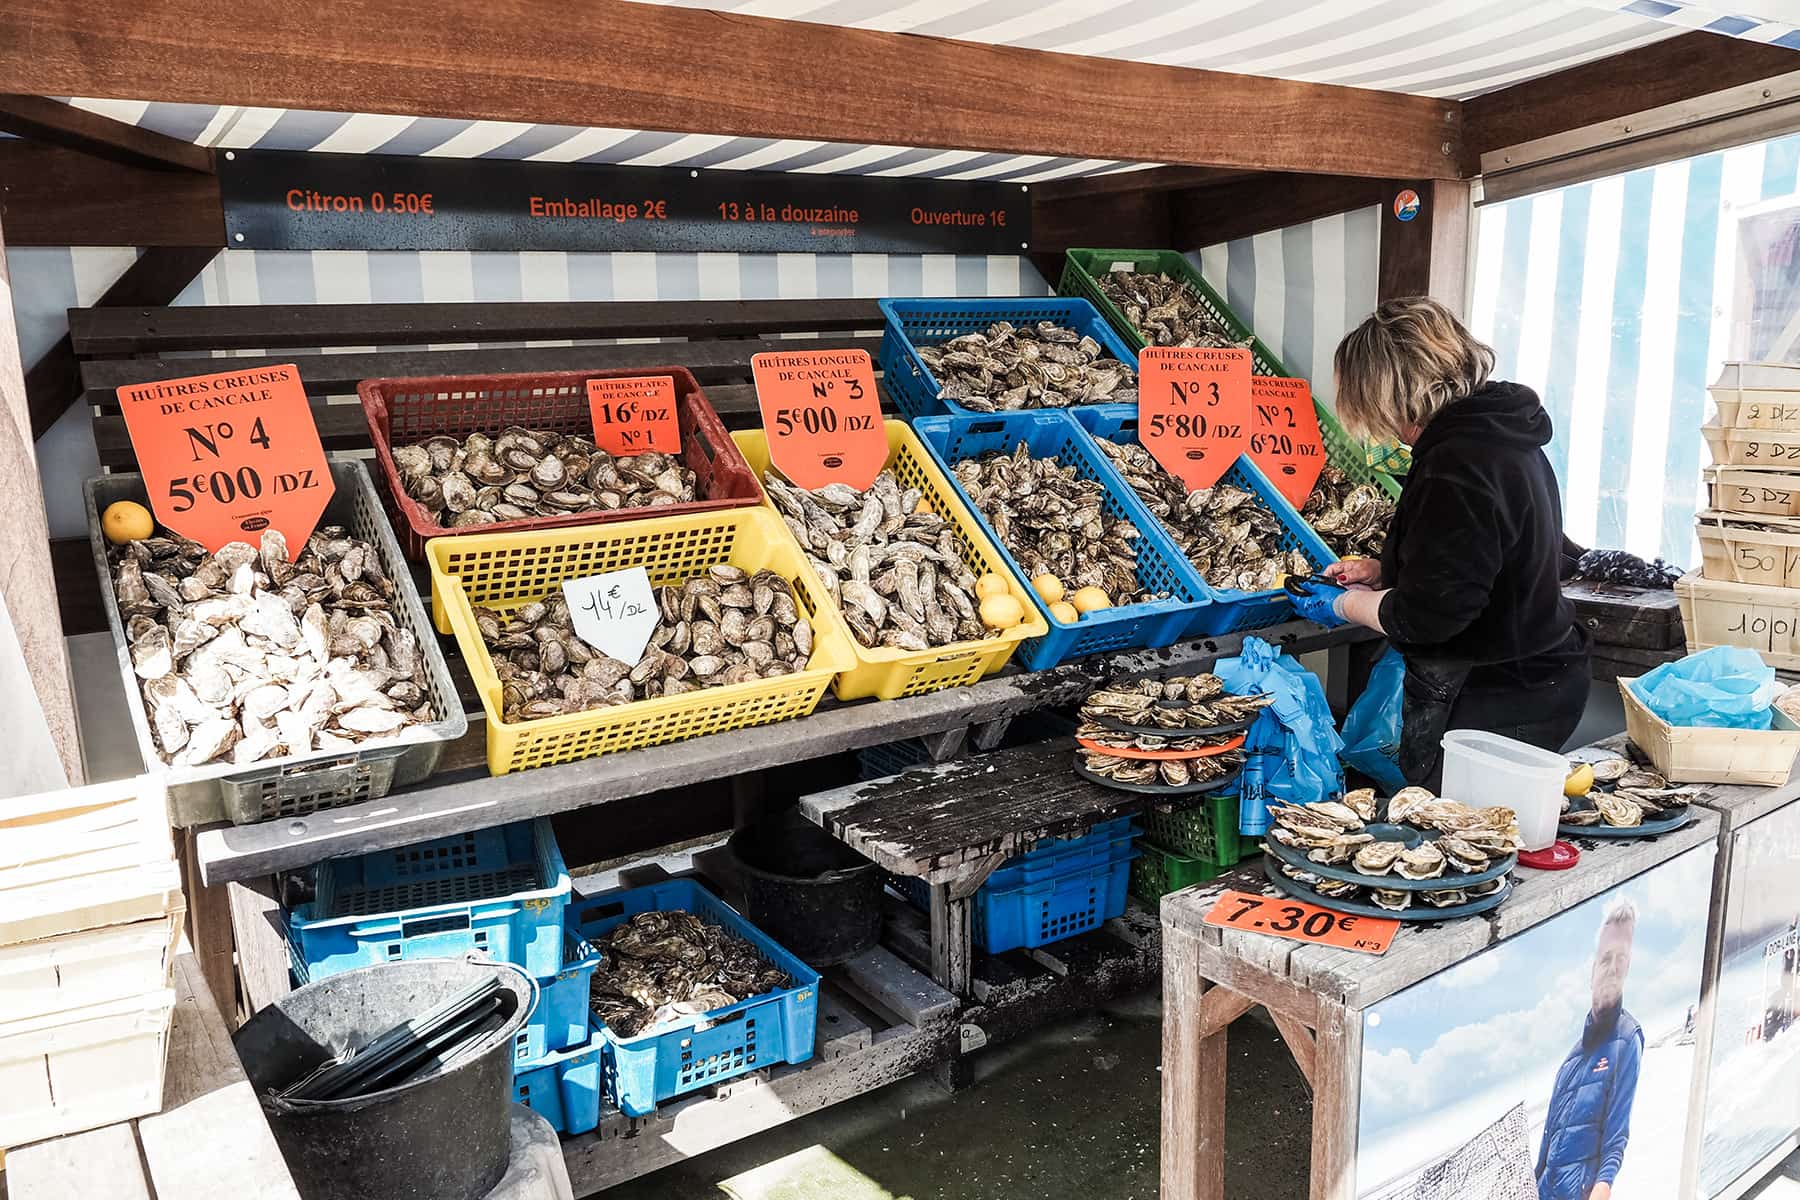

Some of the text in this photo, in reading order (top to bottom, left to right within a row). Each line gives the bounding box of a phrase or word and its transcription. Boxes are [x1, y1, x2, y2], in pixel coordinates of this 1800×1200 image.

[286, 189, 435, 214] Citron 0.50€
[529, 197, 666, 223] Emballage 2€
[718, 203, 859, 223] 13 à la douzaine
[911, 208, 1006, 226] Ouverture 1€
[759, 354, 866, 368] HUÎTRES LONGUES
[1146, 349, 1244, 361] HUÎTRES CREUSES
[779, 368, 852, 381] DE CANCALE
[1160, 363, 1230, 372] DE CANCALE
[131, 370, 290, 402] HUÎTRES CREUSES
[634, 380, 668, 389] PLATES
[843, 379, 864, 399] 3
[1258, 388, 1297, 398] CANCALE
[1269, 380, 1305, 389] CREUSES
[160, 389, 273, 416] DE CANCALE
[602, 390, 660, 399] DE CANCALE
[1207, 382, 1220, 407] 3
[1284, 406, 1297, 428] 2
[1747, 404, 1760, 419] 2
[844, 415, 875, 432] /DZ
[1212, 425, 1242, 439] /DZ
[250, 416, 271, 450] 4
[646, 430, 655, 445] 1
[1745, 441, 1800, 460] 2 DZ
[273, 469, 319, 494] /DZ
[1739, 487, 1791, 505] 3 DZ
[1226, 898, 1358, 937] 7.30€
